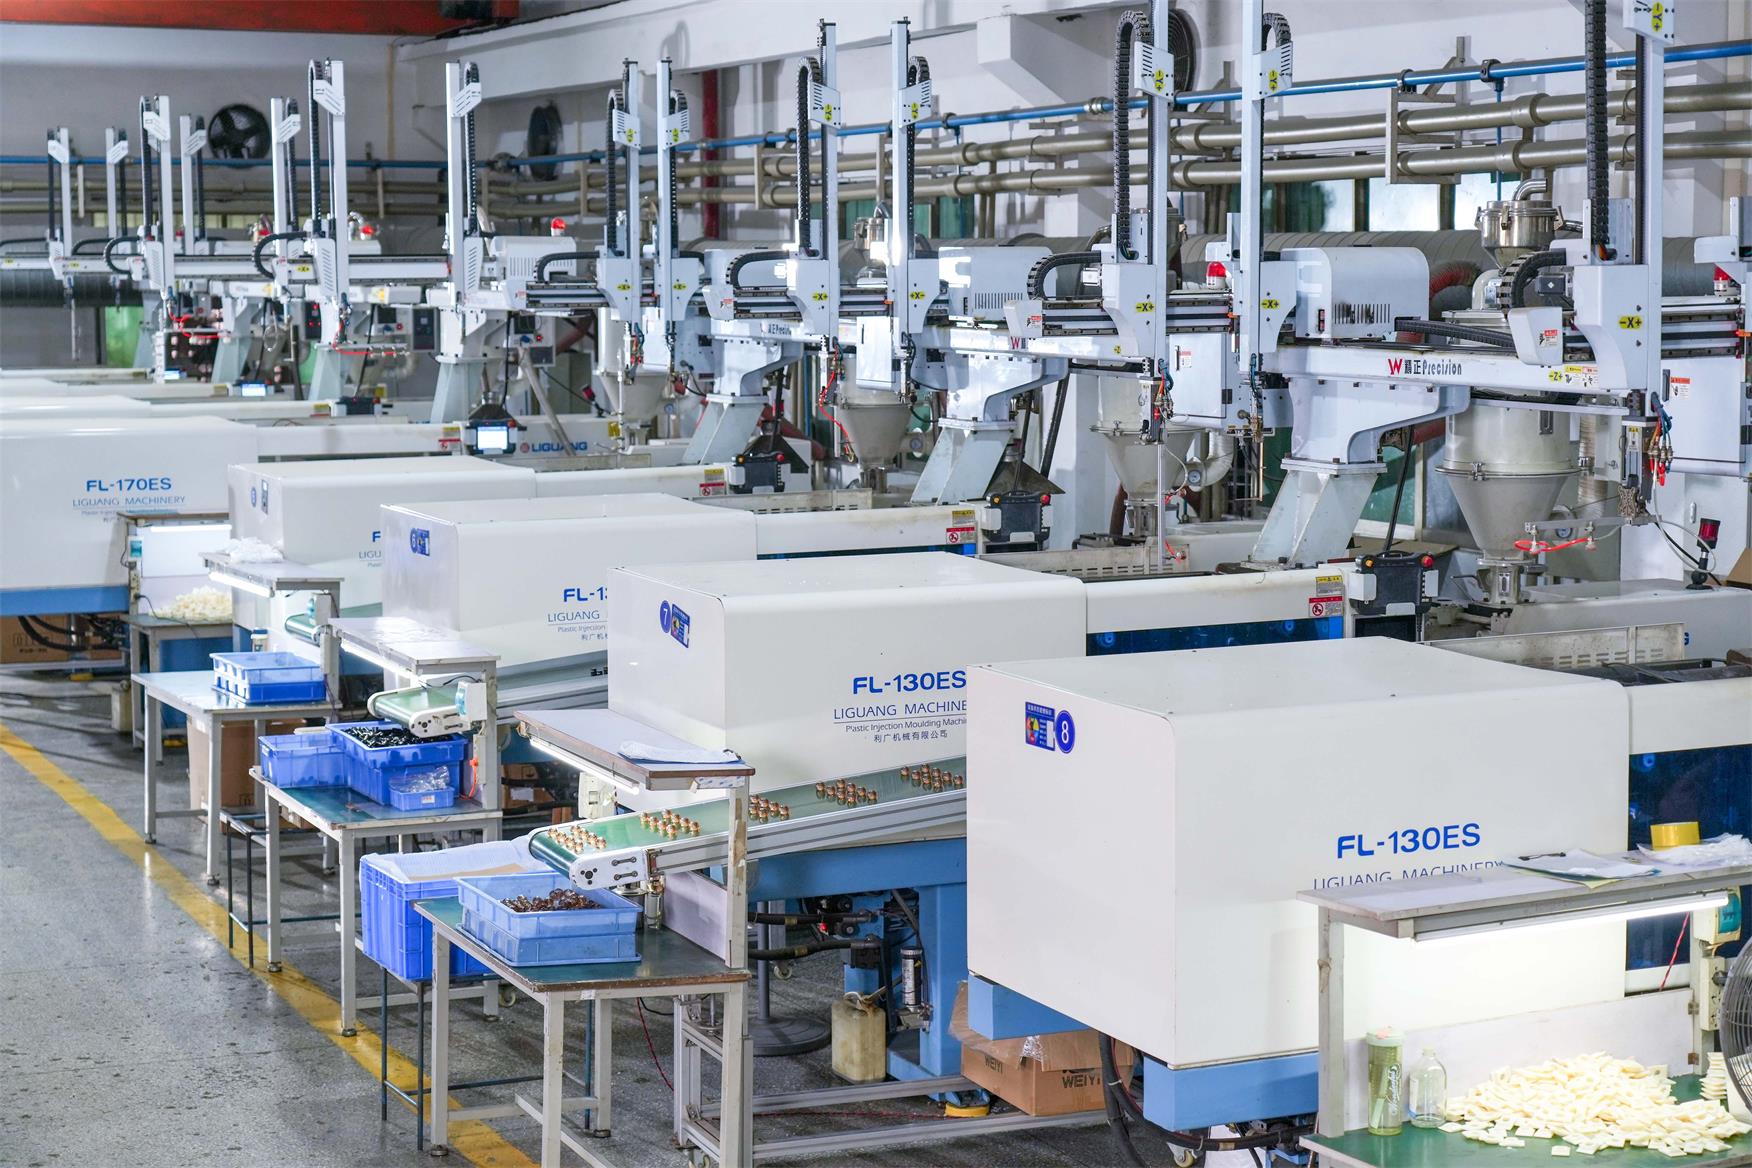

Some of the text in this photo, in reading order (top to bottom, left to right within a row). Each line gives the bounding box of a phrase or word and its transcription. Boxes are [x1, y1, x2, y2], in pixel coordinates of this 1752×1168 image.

[86, 477, 172, 492] FL-170ES
[72, 495, 186, 507] LIGUANG MACHINERY
[547, 610, 600, 622] LIGUANG
[853, 670, 967, 694] FL-130ES
[834, 705, 897, 719] LIGUANG
[870, 721, 903, 732] Injection
[905, 718, 940, 729] Moulding
[1337, 823, 1480, 858] FL-130ES
